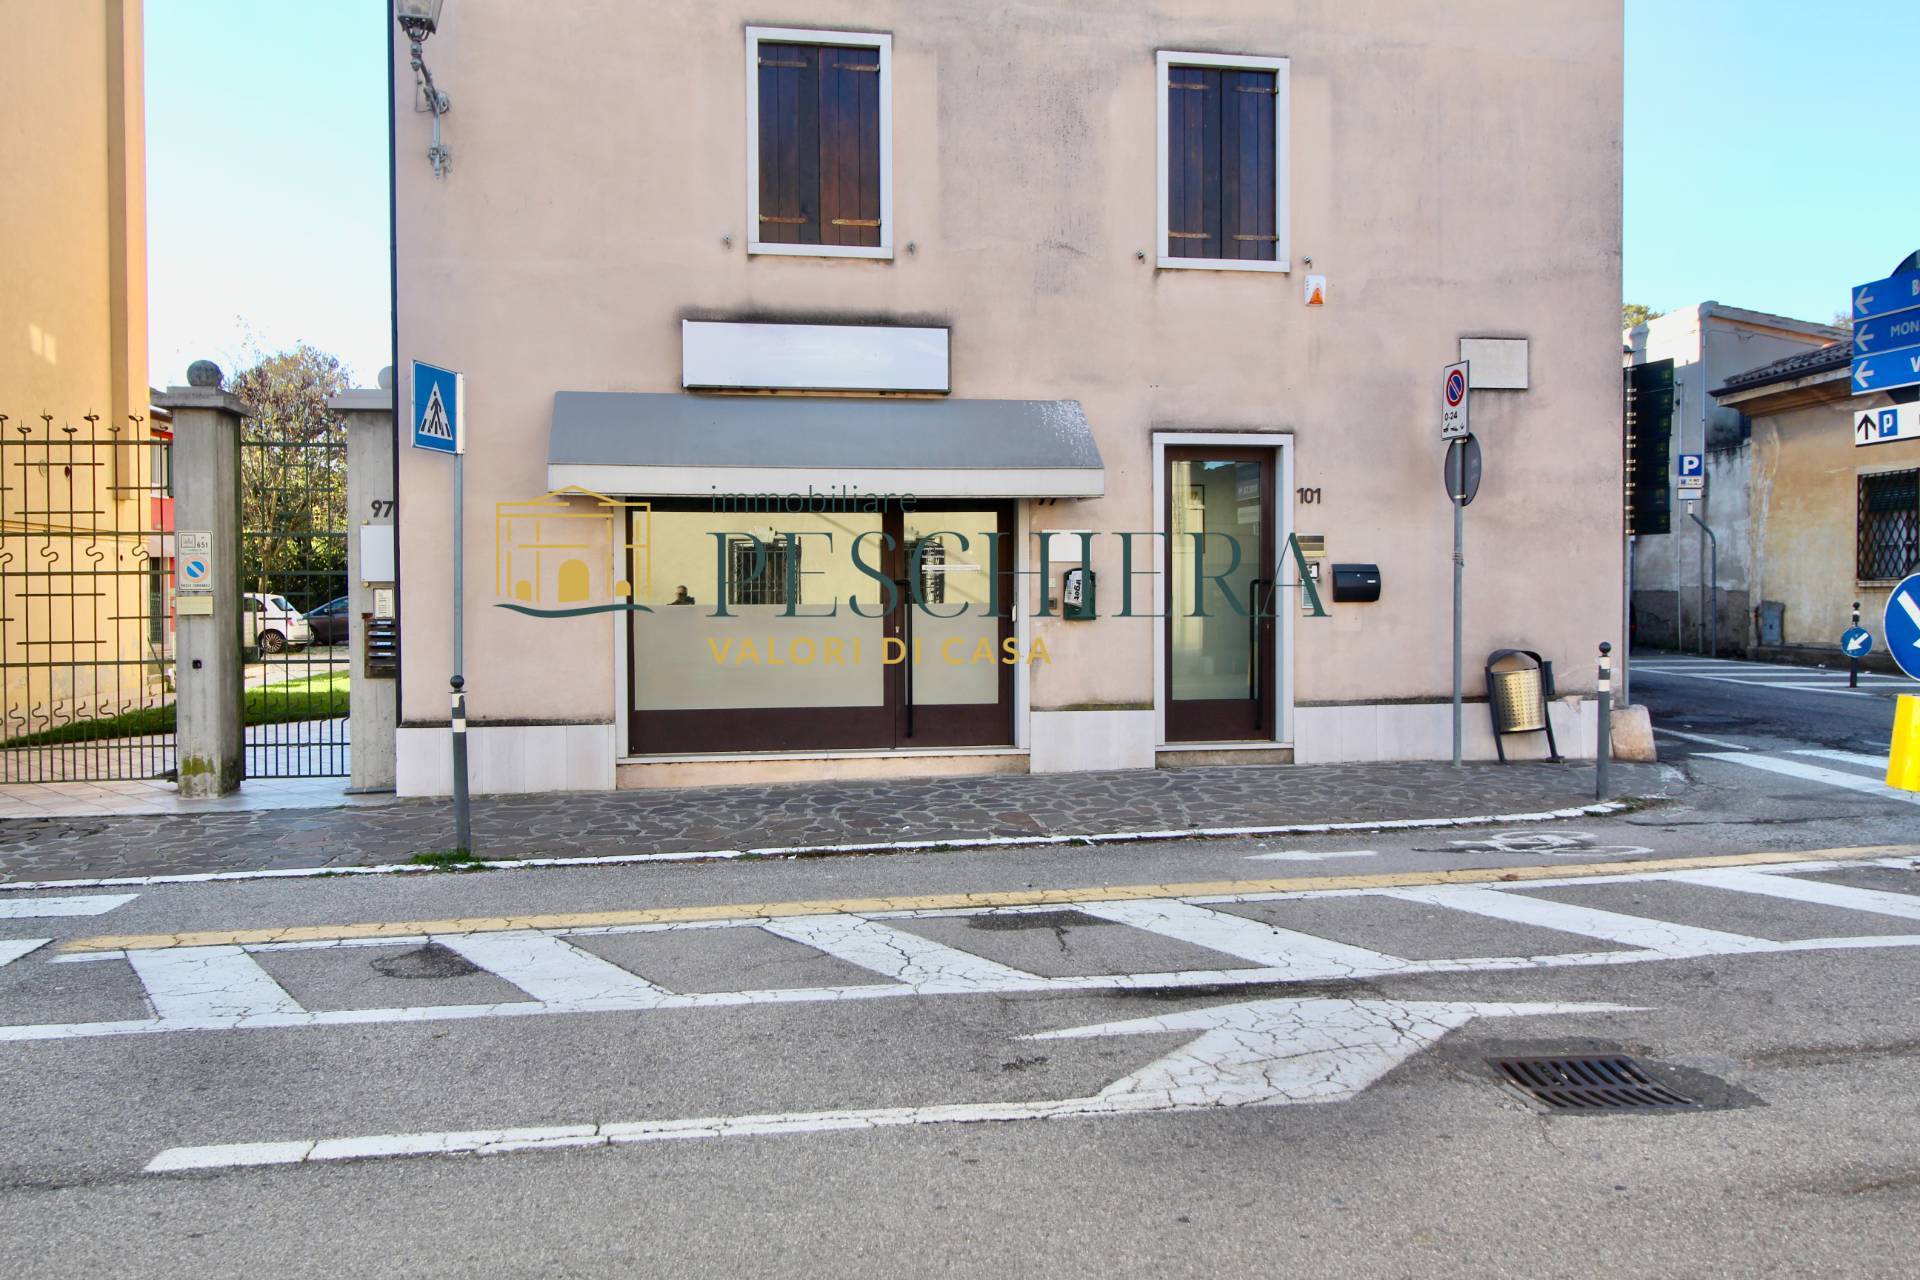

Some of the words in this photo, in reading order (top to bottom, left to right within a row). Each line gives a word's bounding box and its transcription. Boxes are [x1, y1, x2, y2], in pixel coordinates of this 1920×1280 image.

[1883, 414, 1893, 433] P
[1683, 456, 1699, 475] P
[1297, 488, 1321, 504] 101
[371, 500, 393, 518] 97
